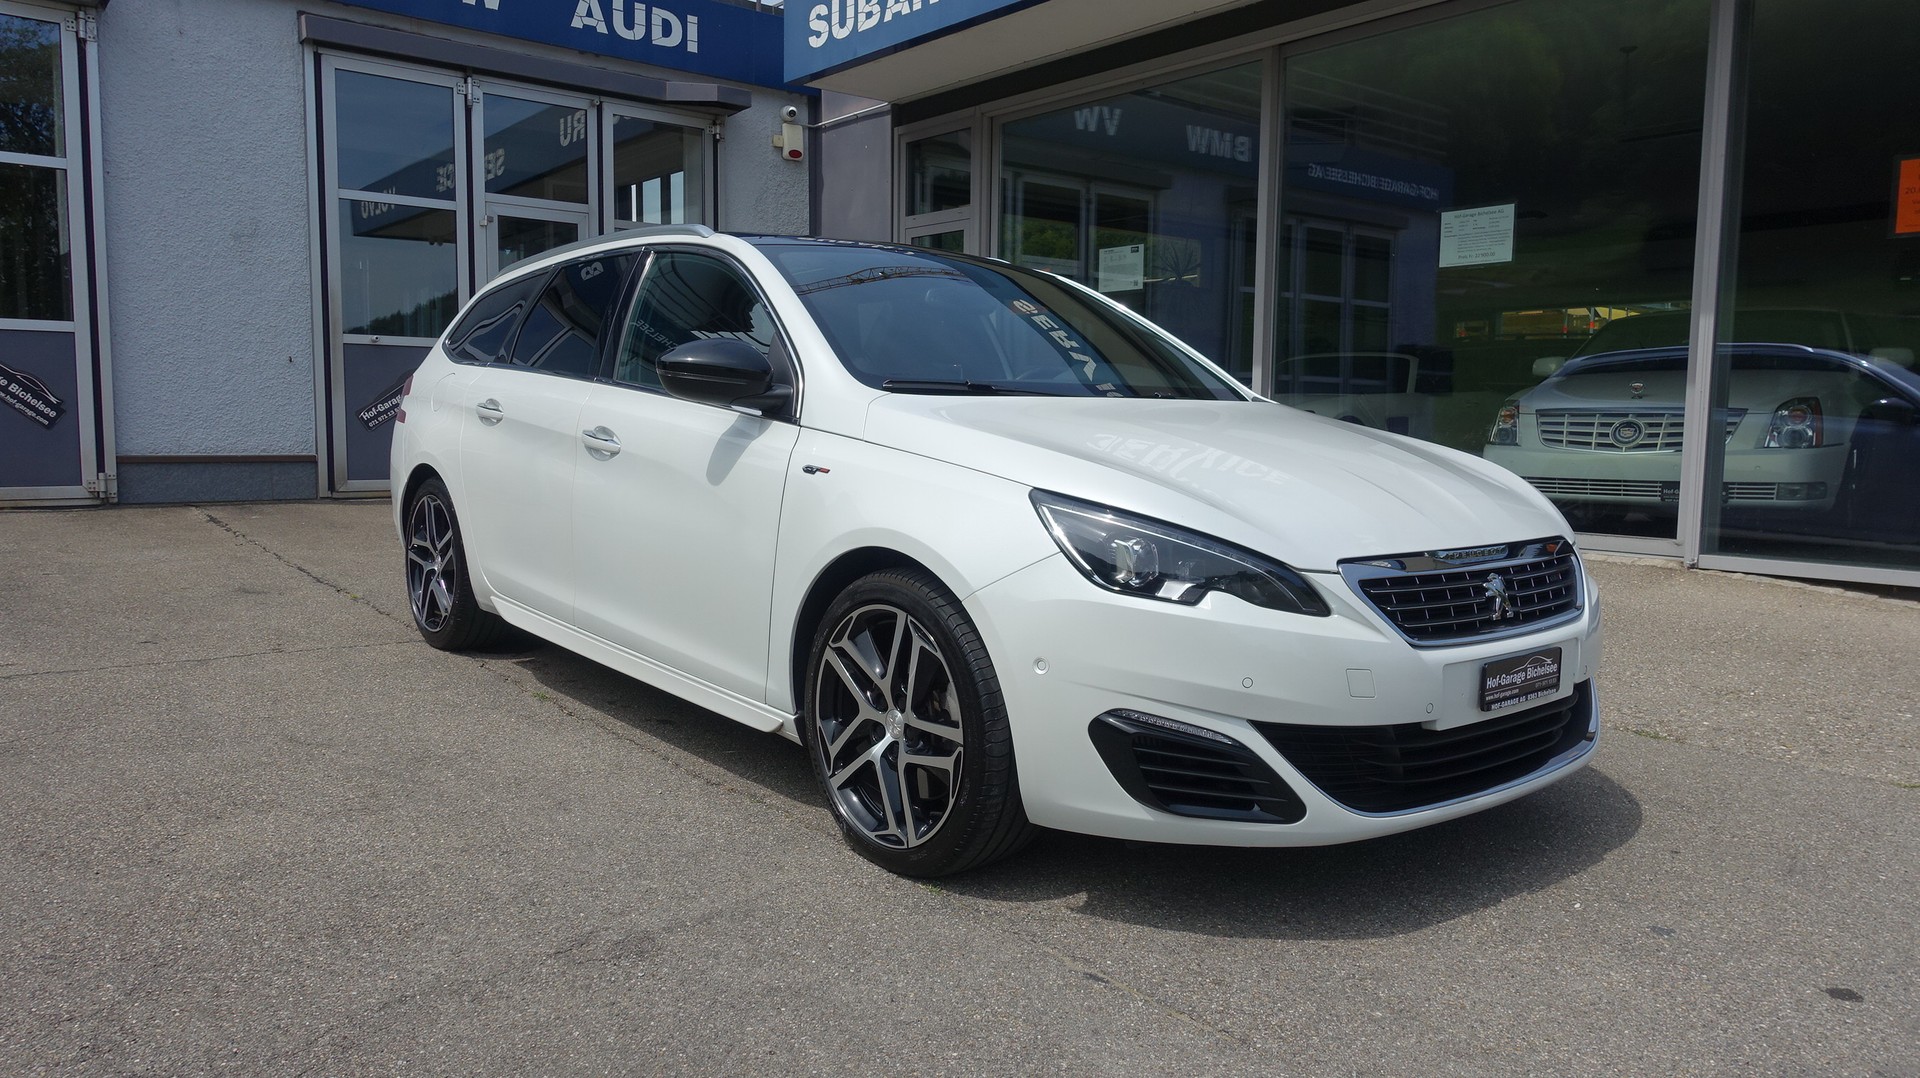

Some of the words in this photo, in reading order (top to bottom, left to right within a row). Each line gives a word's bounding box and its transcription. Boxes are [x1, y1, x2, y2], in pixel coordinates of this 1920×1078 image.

[570, 0, 698, 53] AUDI
[8, 382, 57, 418] Bichelsee
[1452, 546, 1502, 559] PEUGEOT
[1486, 670, 1526, 689] Hof-Garage
[1526, 663, 1558, 679] Bichelsee
[1485, 688, 1520, 701] www.hof-garage.com
[1491, 697, 1519, 710] HOF-GARAGE
[1519, 695, 1526, 704] AG
[1538, 688, 1557, 698] Bichelsee
